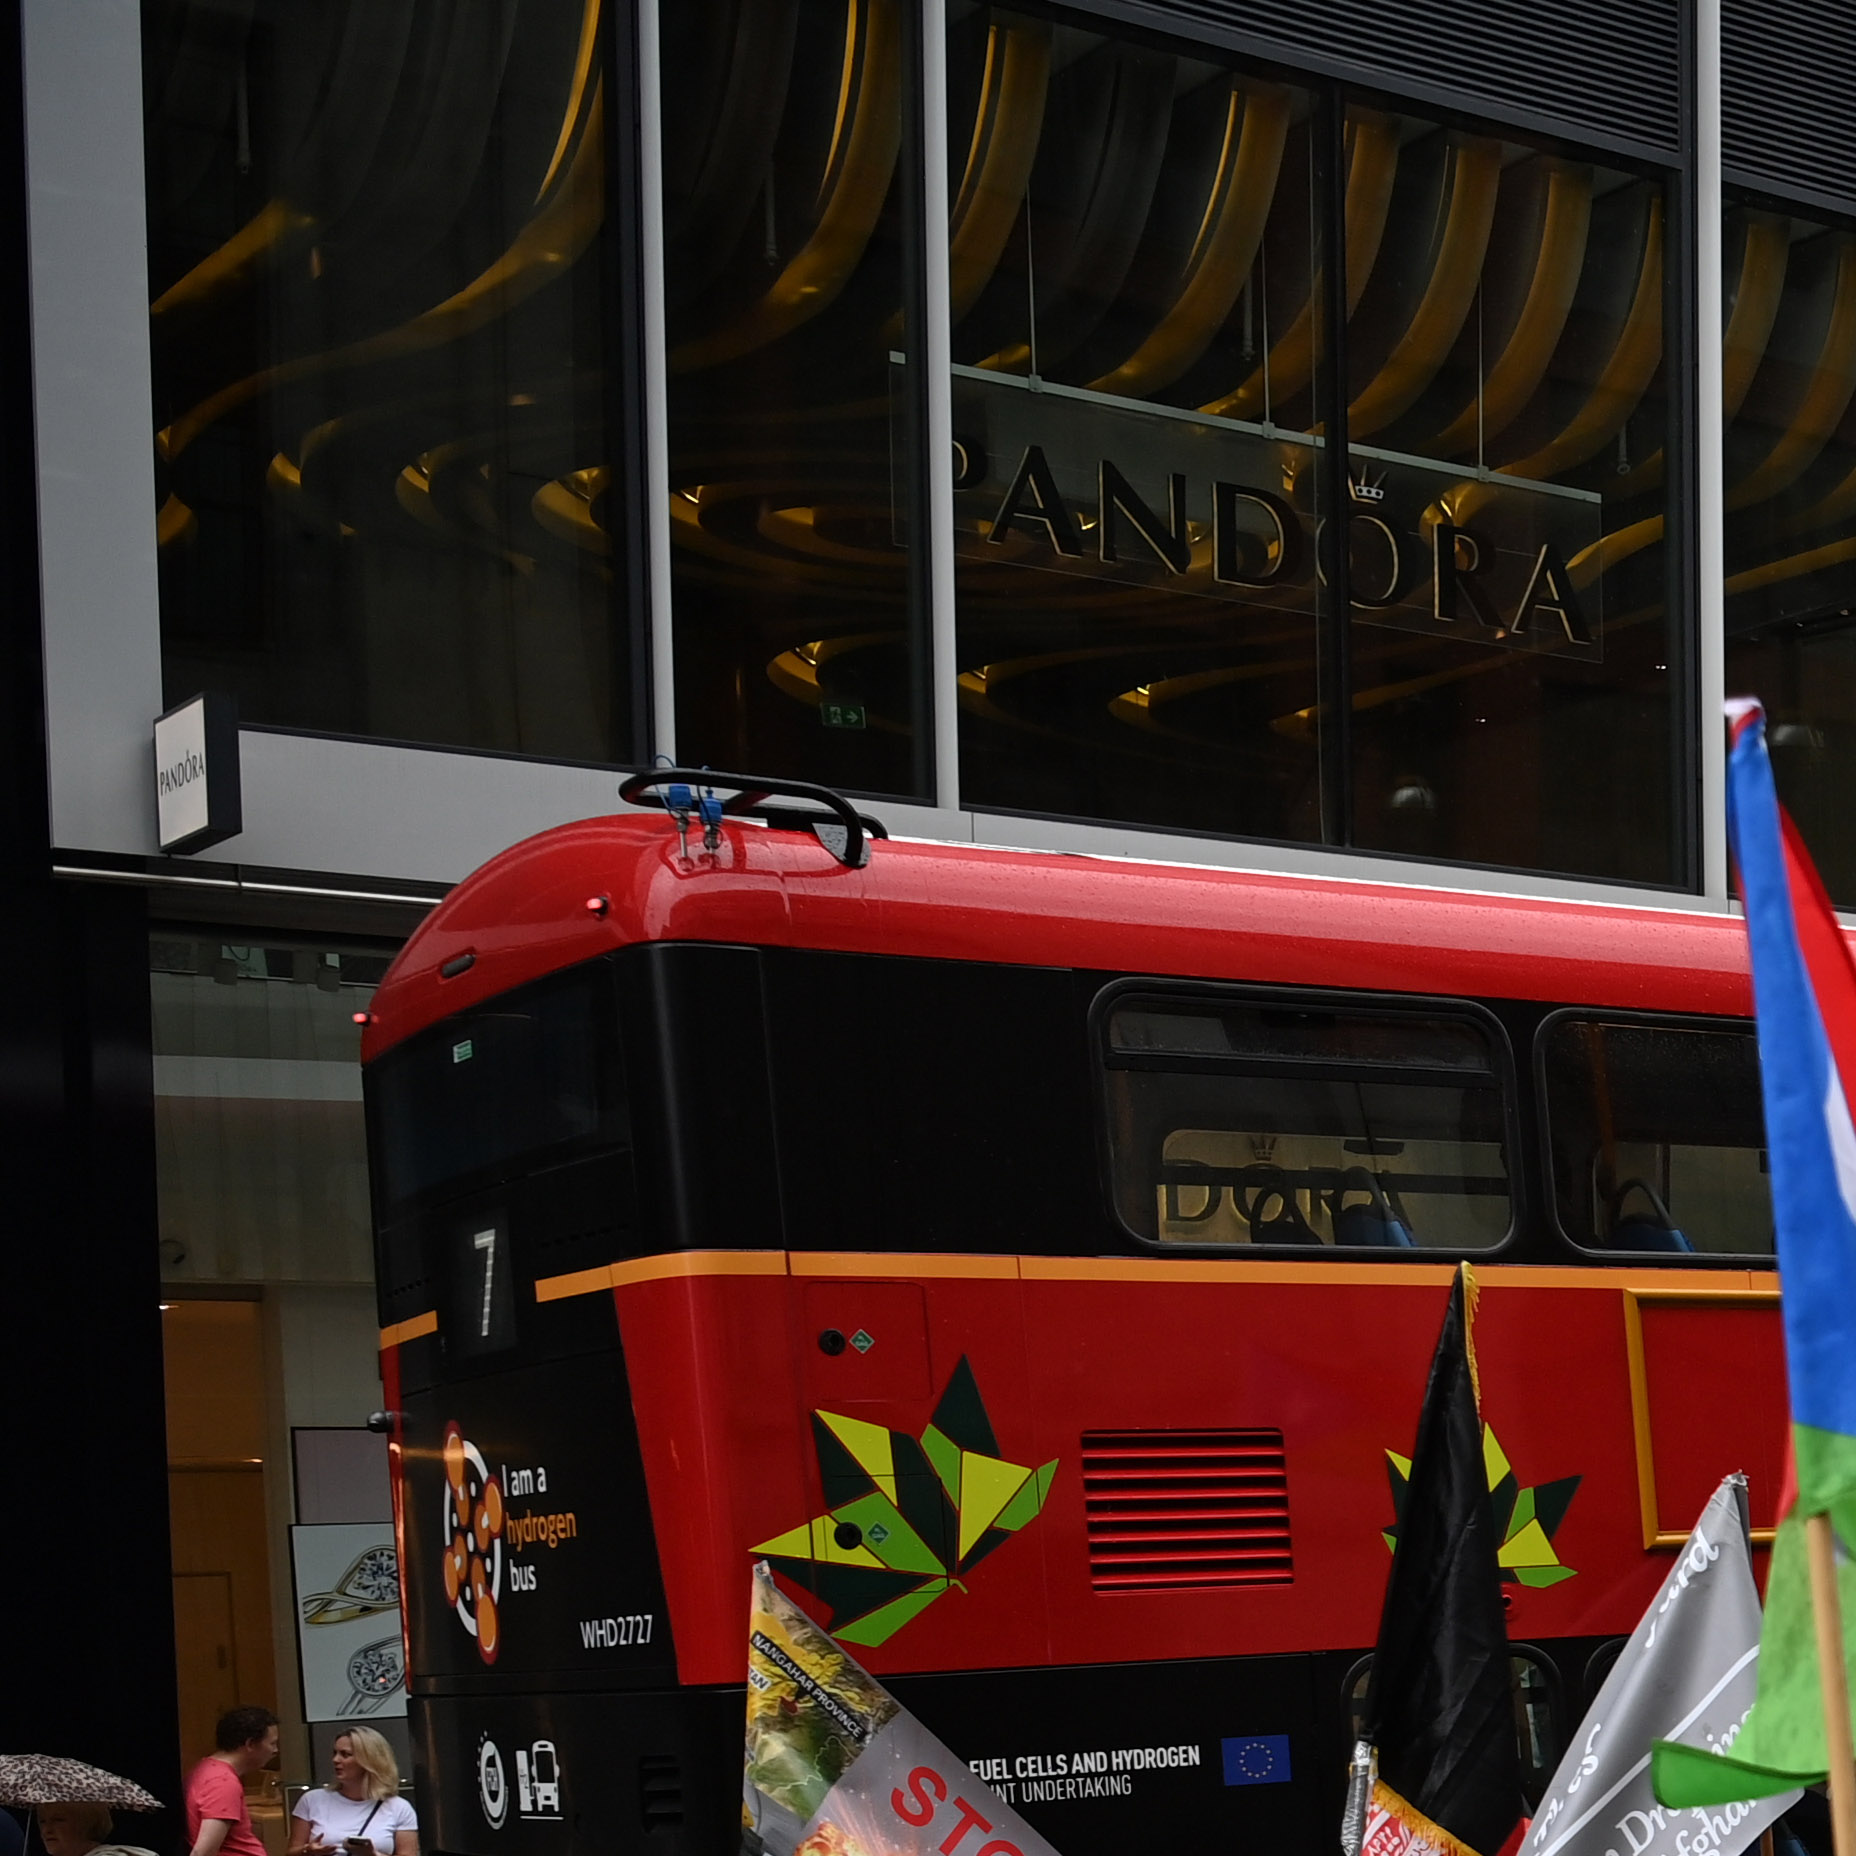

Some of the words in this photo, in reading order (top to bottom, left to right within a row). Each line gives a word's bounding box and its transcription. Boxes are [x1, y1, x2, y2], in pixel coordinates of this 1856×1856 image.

[474, 1229, 496, 1336] 7
[511, 1467, 534, 1497] am
[537, 1466, 547, 1493] a
[505, 1509, 577, 1552] hydrogen
[509, 1558, 537, 1592] bus
[580, 1614, 653, 1648] WHD2727
[752, 1634, 814, 1691] NANGAHAR
[812, 1688, 863, 1738] PROVINCE
[1015, 1754, 1068, 1779] CELLS
[1071, 1750, 1107, 1775] AND
[1112, 1745, 1200, 1771] HYDROGEN
[1022, 1775, 1132, 1803] UNDERTAKING
